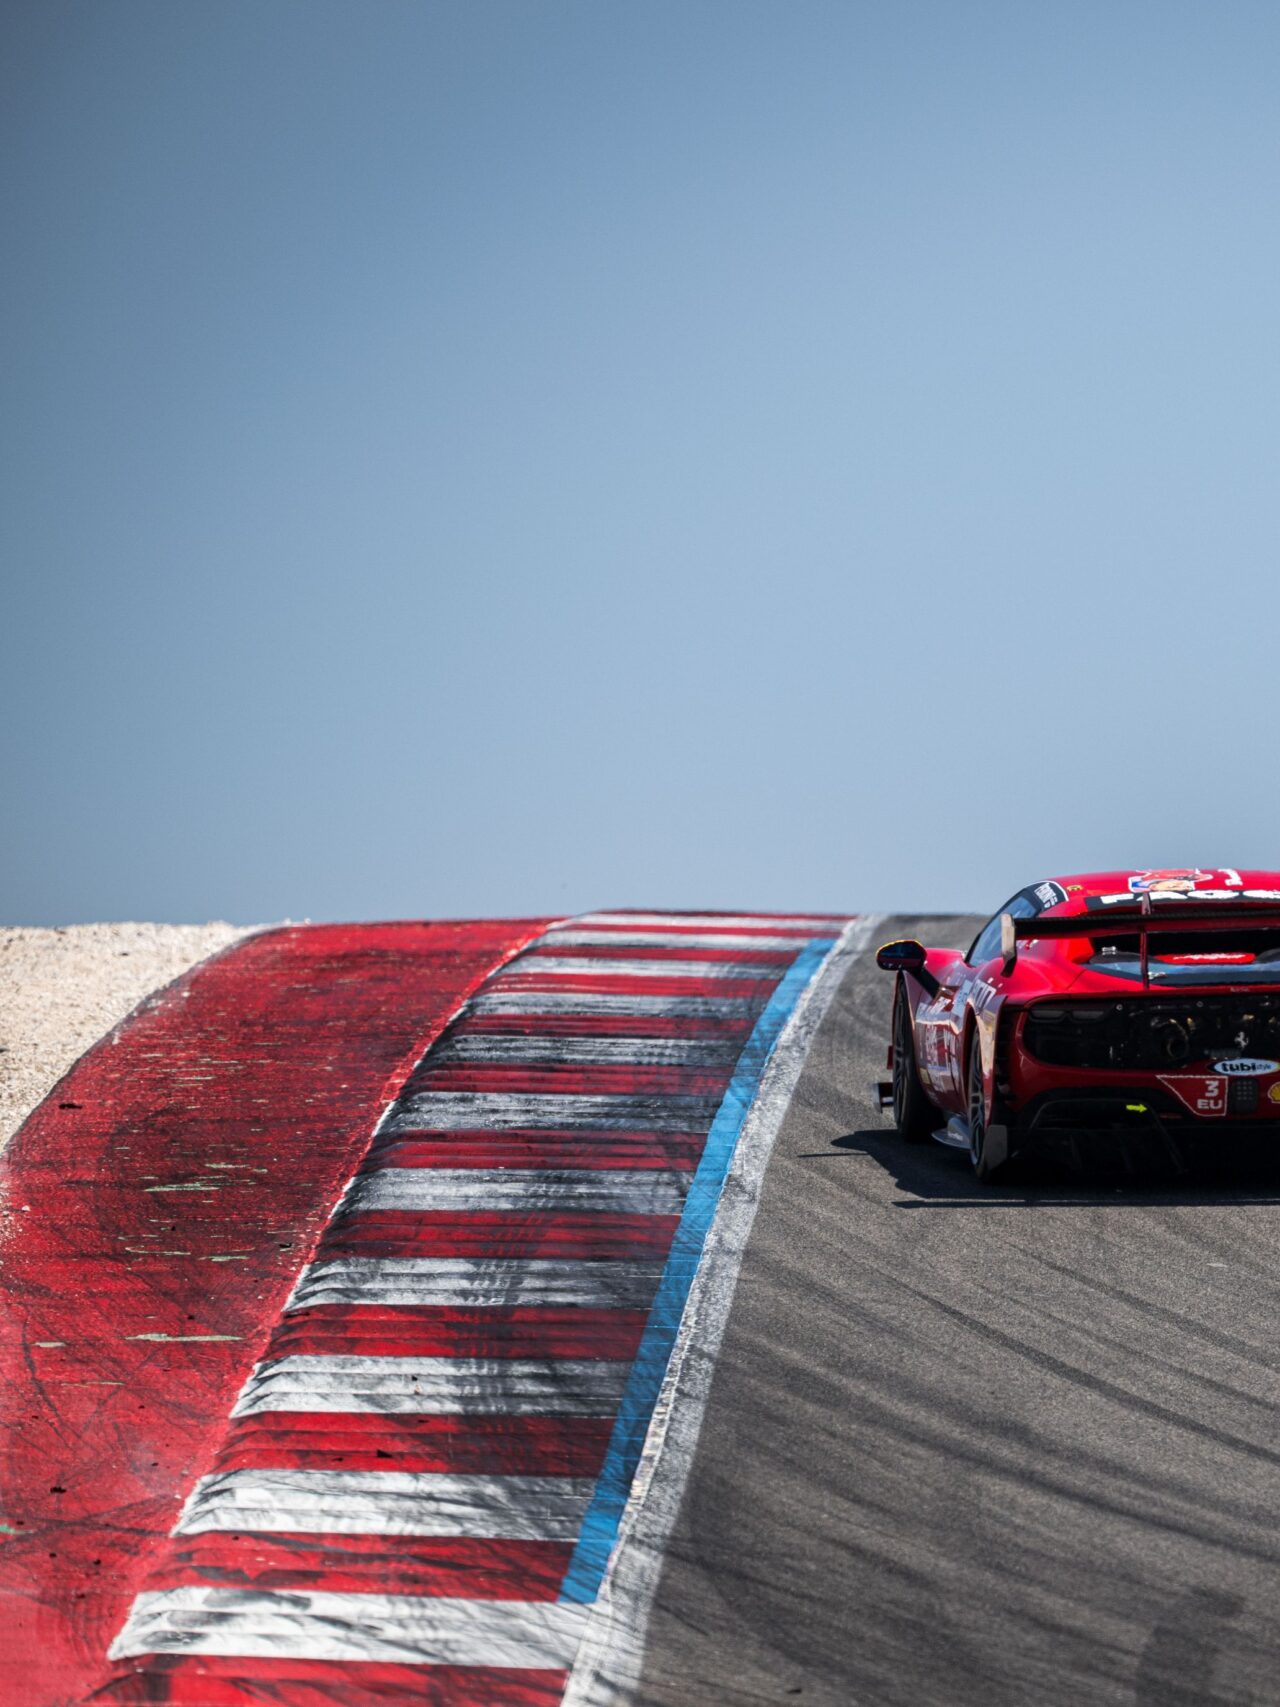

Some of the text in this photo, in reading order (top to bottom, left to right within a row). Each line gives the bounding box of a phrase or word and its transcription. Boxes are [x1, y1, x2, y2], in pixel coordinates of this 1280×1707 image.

[1221, 1062, 1256, 1072] tubi
[1205, 1080, 1219, 1097] 3
[1197, 1099, 1222, 1109] EU
